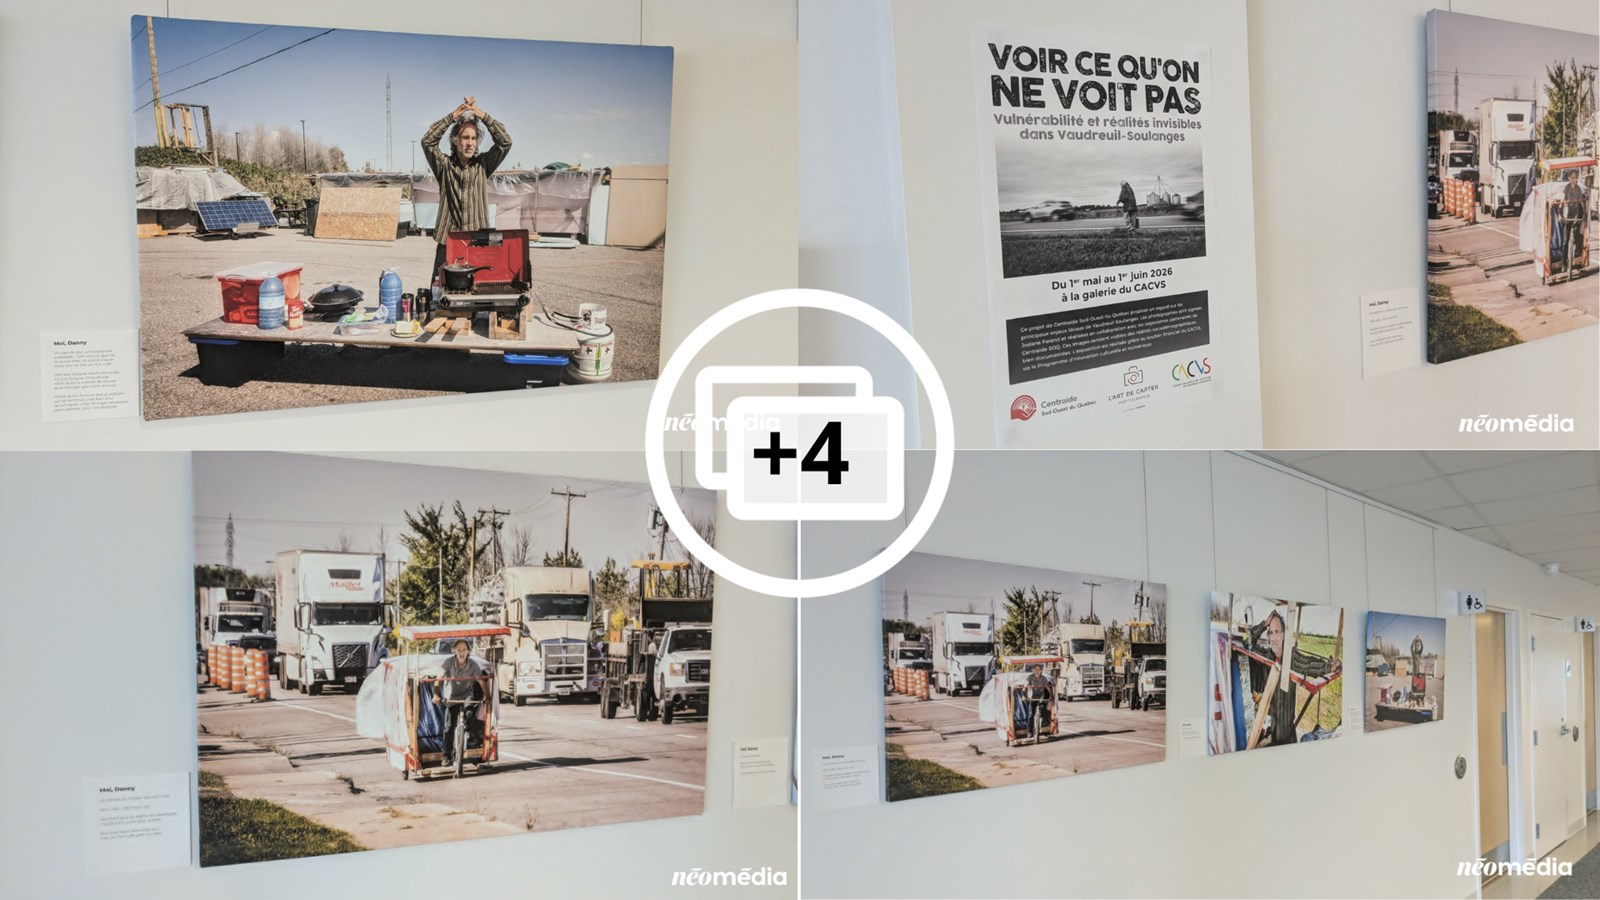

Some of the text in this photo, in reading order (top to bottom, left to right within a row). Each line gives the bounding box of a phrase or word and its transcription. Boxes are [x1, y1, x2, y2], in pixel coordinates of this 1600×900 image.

[988, 43, 1200, 83] VOIR CE QU'ON
[991, 75, 1201, 114] NE VOIT PAS
[993, 113, 1201, 129] Vulnérabilité et réalités invisibles
[1020, 128, 1185, 143] dans Vaudreuil-Soulanges
[1052, 281, 1066, 290] Du
[1070, 279, 1079, 287] 1er
[1083, 276, 1101, 286] mai
[1118, 273, 1128, 282] 1er
[1130, 270, 1148, 282] juin
[1150, 267, 1173, 277] 2026
[1062, 281, 1166, 302] à la galerie du CACVS
[1041, 396, 1078, 408] Centraide
[1108, 392, 1124, 401] L'ART
[1136, 385, 1159, 394] CAPTER
